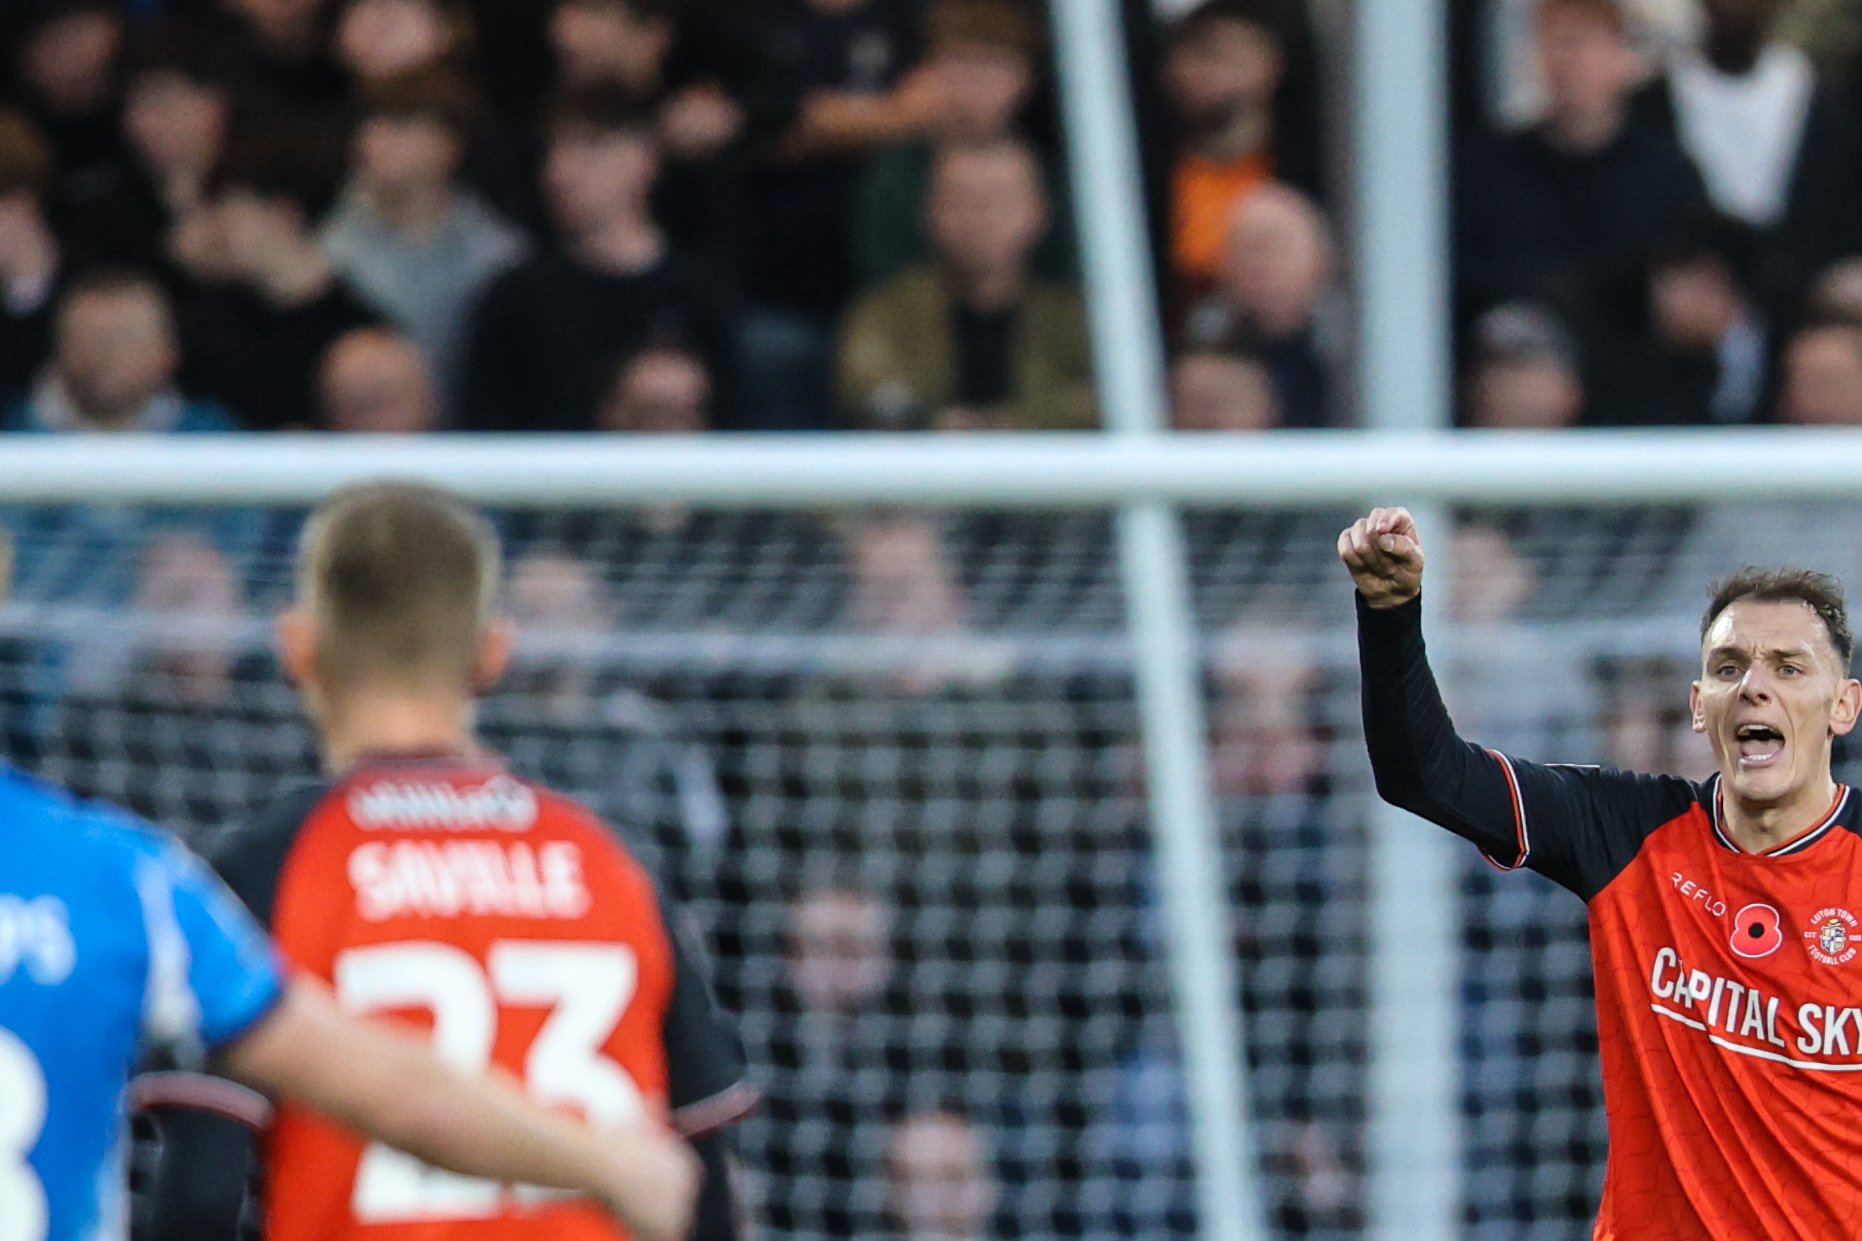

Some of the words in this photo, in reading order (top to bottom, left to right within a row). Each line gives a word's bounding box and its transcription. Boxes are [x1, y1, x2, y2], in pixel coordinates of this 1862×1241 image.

[346, 837, 594, 923] SAVILLE
[1671, 871, 1727, 917] REFLO
[1836, 908, 1859, 928] TOWN
[1651, 946, 1786, 1048] CAPITAL
